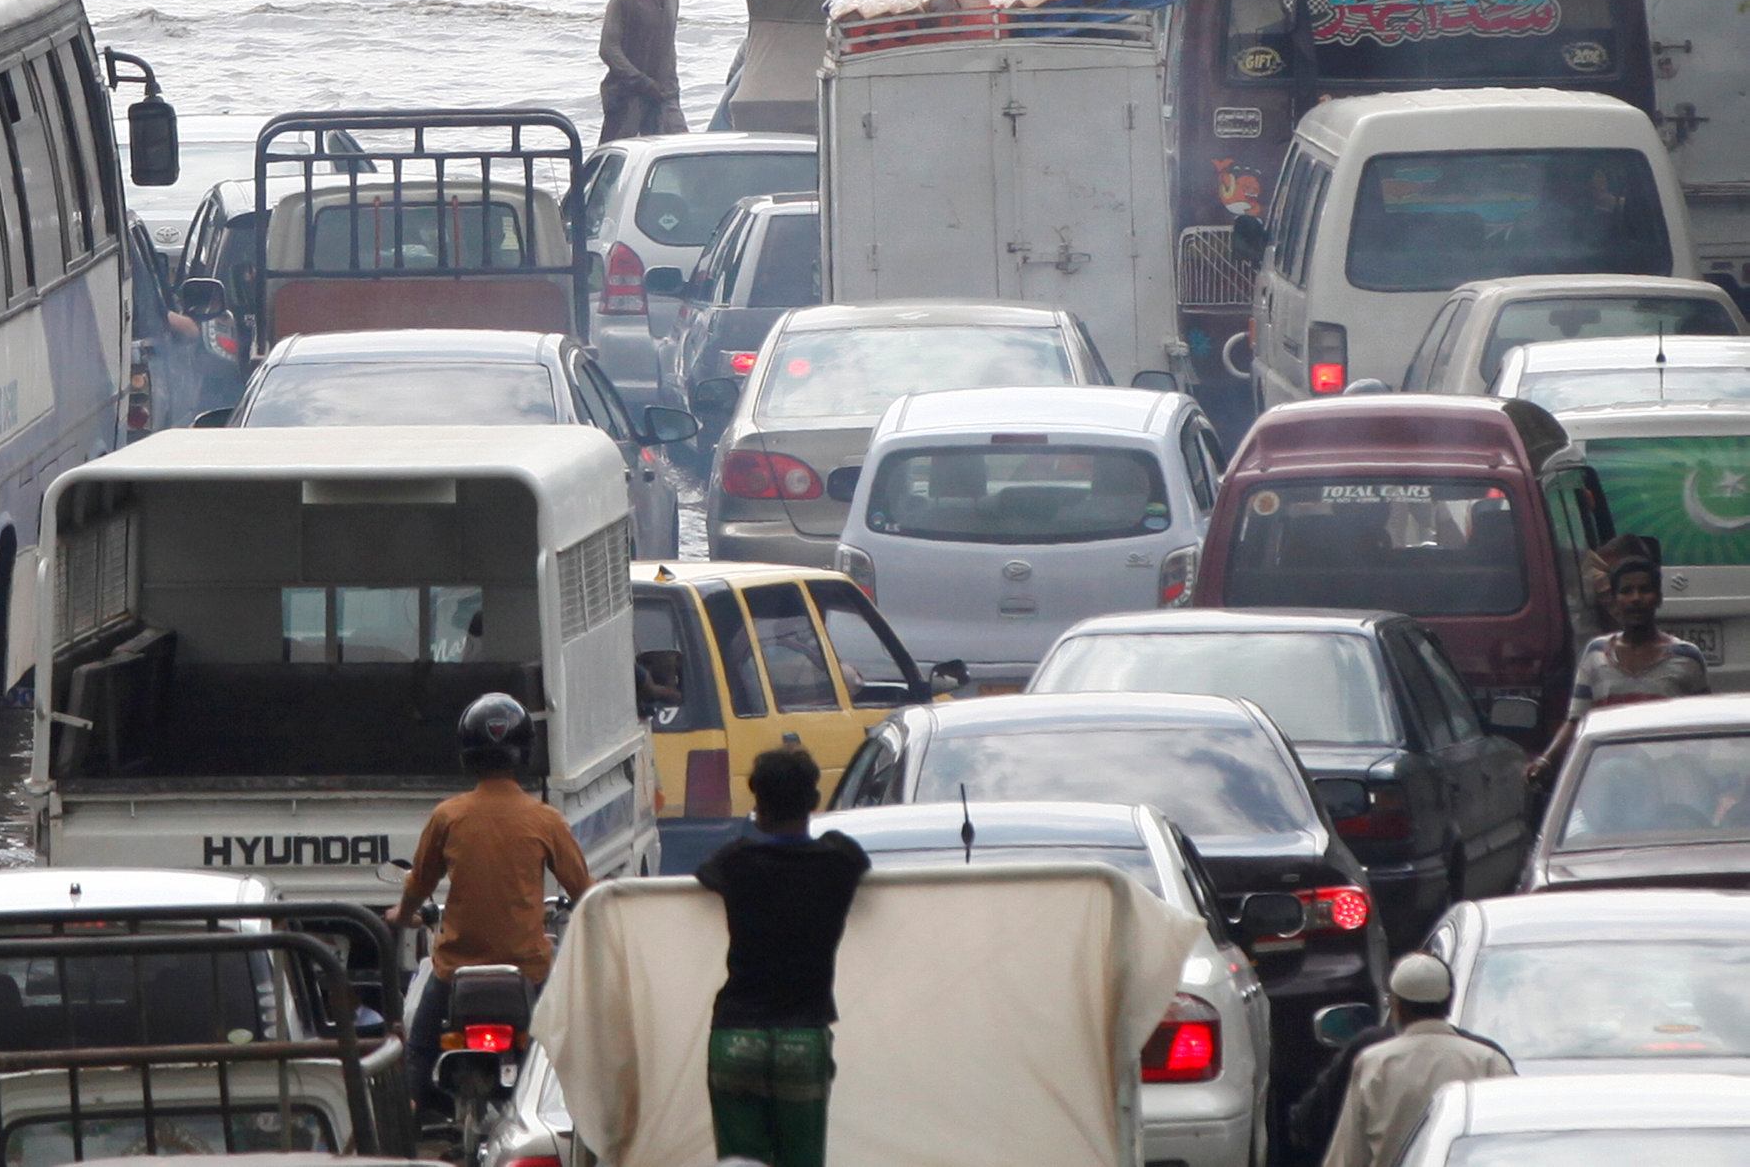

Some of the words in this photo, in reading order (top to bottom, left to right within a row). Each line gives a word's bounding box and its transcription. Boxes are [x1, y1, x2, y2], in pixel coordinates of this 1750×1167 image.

[1245, 52, 1272, 70] GIFT
[1322, 485, 1374, 498] TOTAL
[1380, 485, 1432, 498] CARS
[203, 834, 390, 866] HYUNDAI
